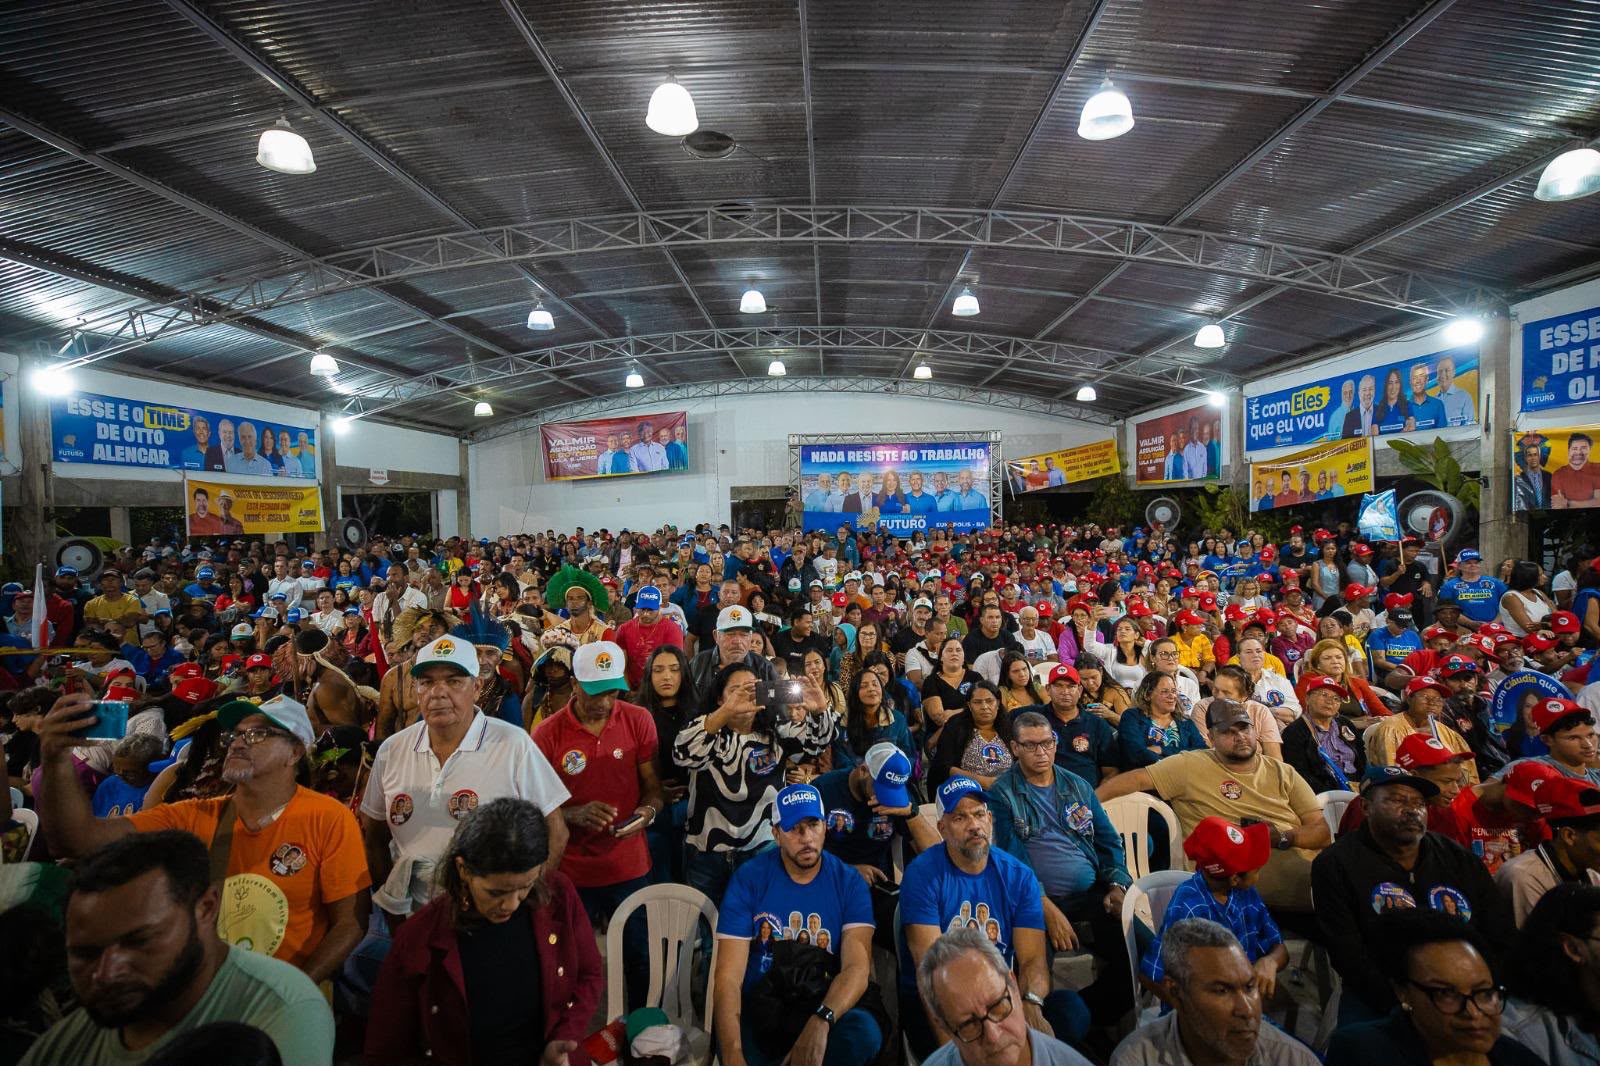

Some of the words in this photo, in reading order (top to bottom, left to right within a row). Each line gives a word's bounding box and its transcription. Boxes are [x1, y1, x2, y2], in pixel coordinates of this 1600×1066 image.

[1539, 316, 1600, 350] ESSE
[1551, 348, 1584, 376] DE
[1568, 375, 1600, 400] OL
[1252, 398, 1260, 420] É
[1262, 400, 1290, 418] com
[1294, 392, 1323, 411] Eles
[1527, 394, 1555, 404] FUTURO
[67, 398, 115, 420] ESSE
[118, 403, 129, 422] É
[132, 406, 144, 423] O
[146, 409, 185, 428] TIME
[96, 421, 120, 441] DE
[123, 425, 165, 446] OTTO
[1250, 421, 1274, 440] que
[1276, 418, 1294, 434] eu
[1297, 412, 1325, 430] vou
[549, 436, 596, 446] VALMIR
[1139, 435, 1164, 447] VALMIR
[92, 443, 170, 465] ALENCAR
[811, 451, 845, 463] NADA
[847, 450, 899, 462] RESISTE
[901, 450, 918, 461] AO
[920, 448, 985, 461] TRABALHO
[880, 519, 926, 529] FUTURO
[1503, 673, 1537, 690] Cláudia
[1538, 678, 1558, 694] que
[1497, 689, 1507, 710] com
[1495, 710, 1503, 718] é
